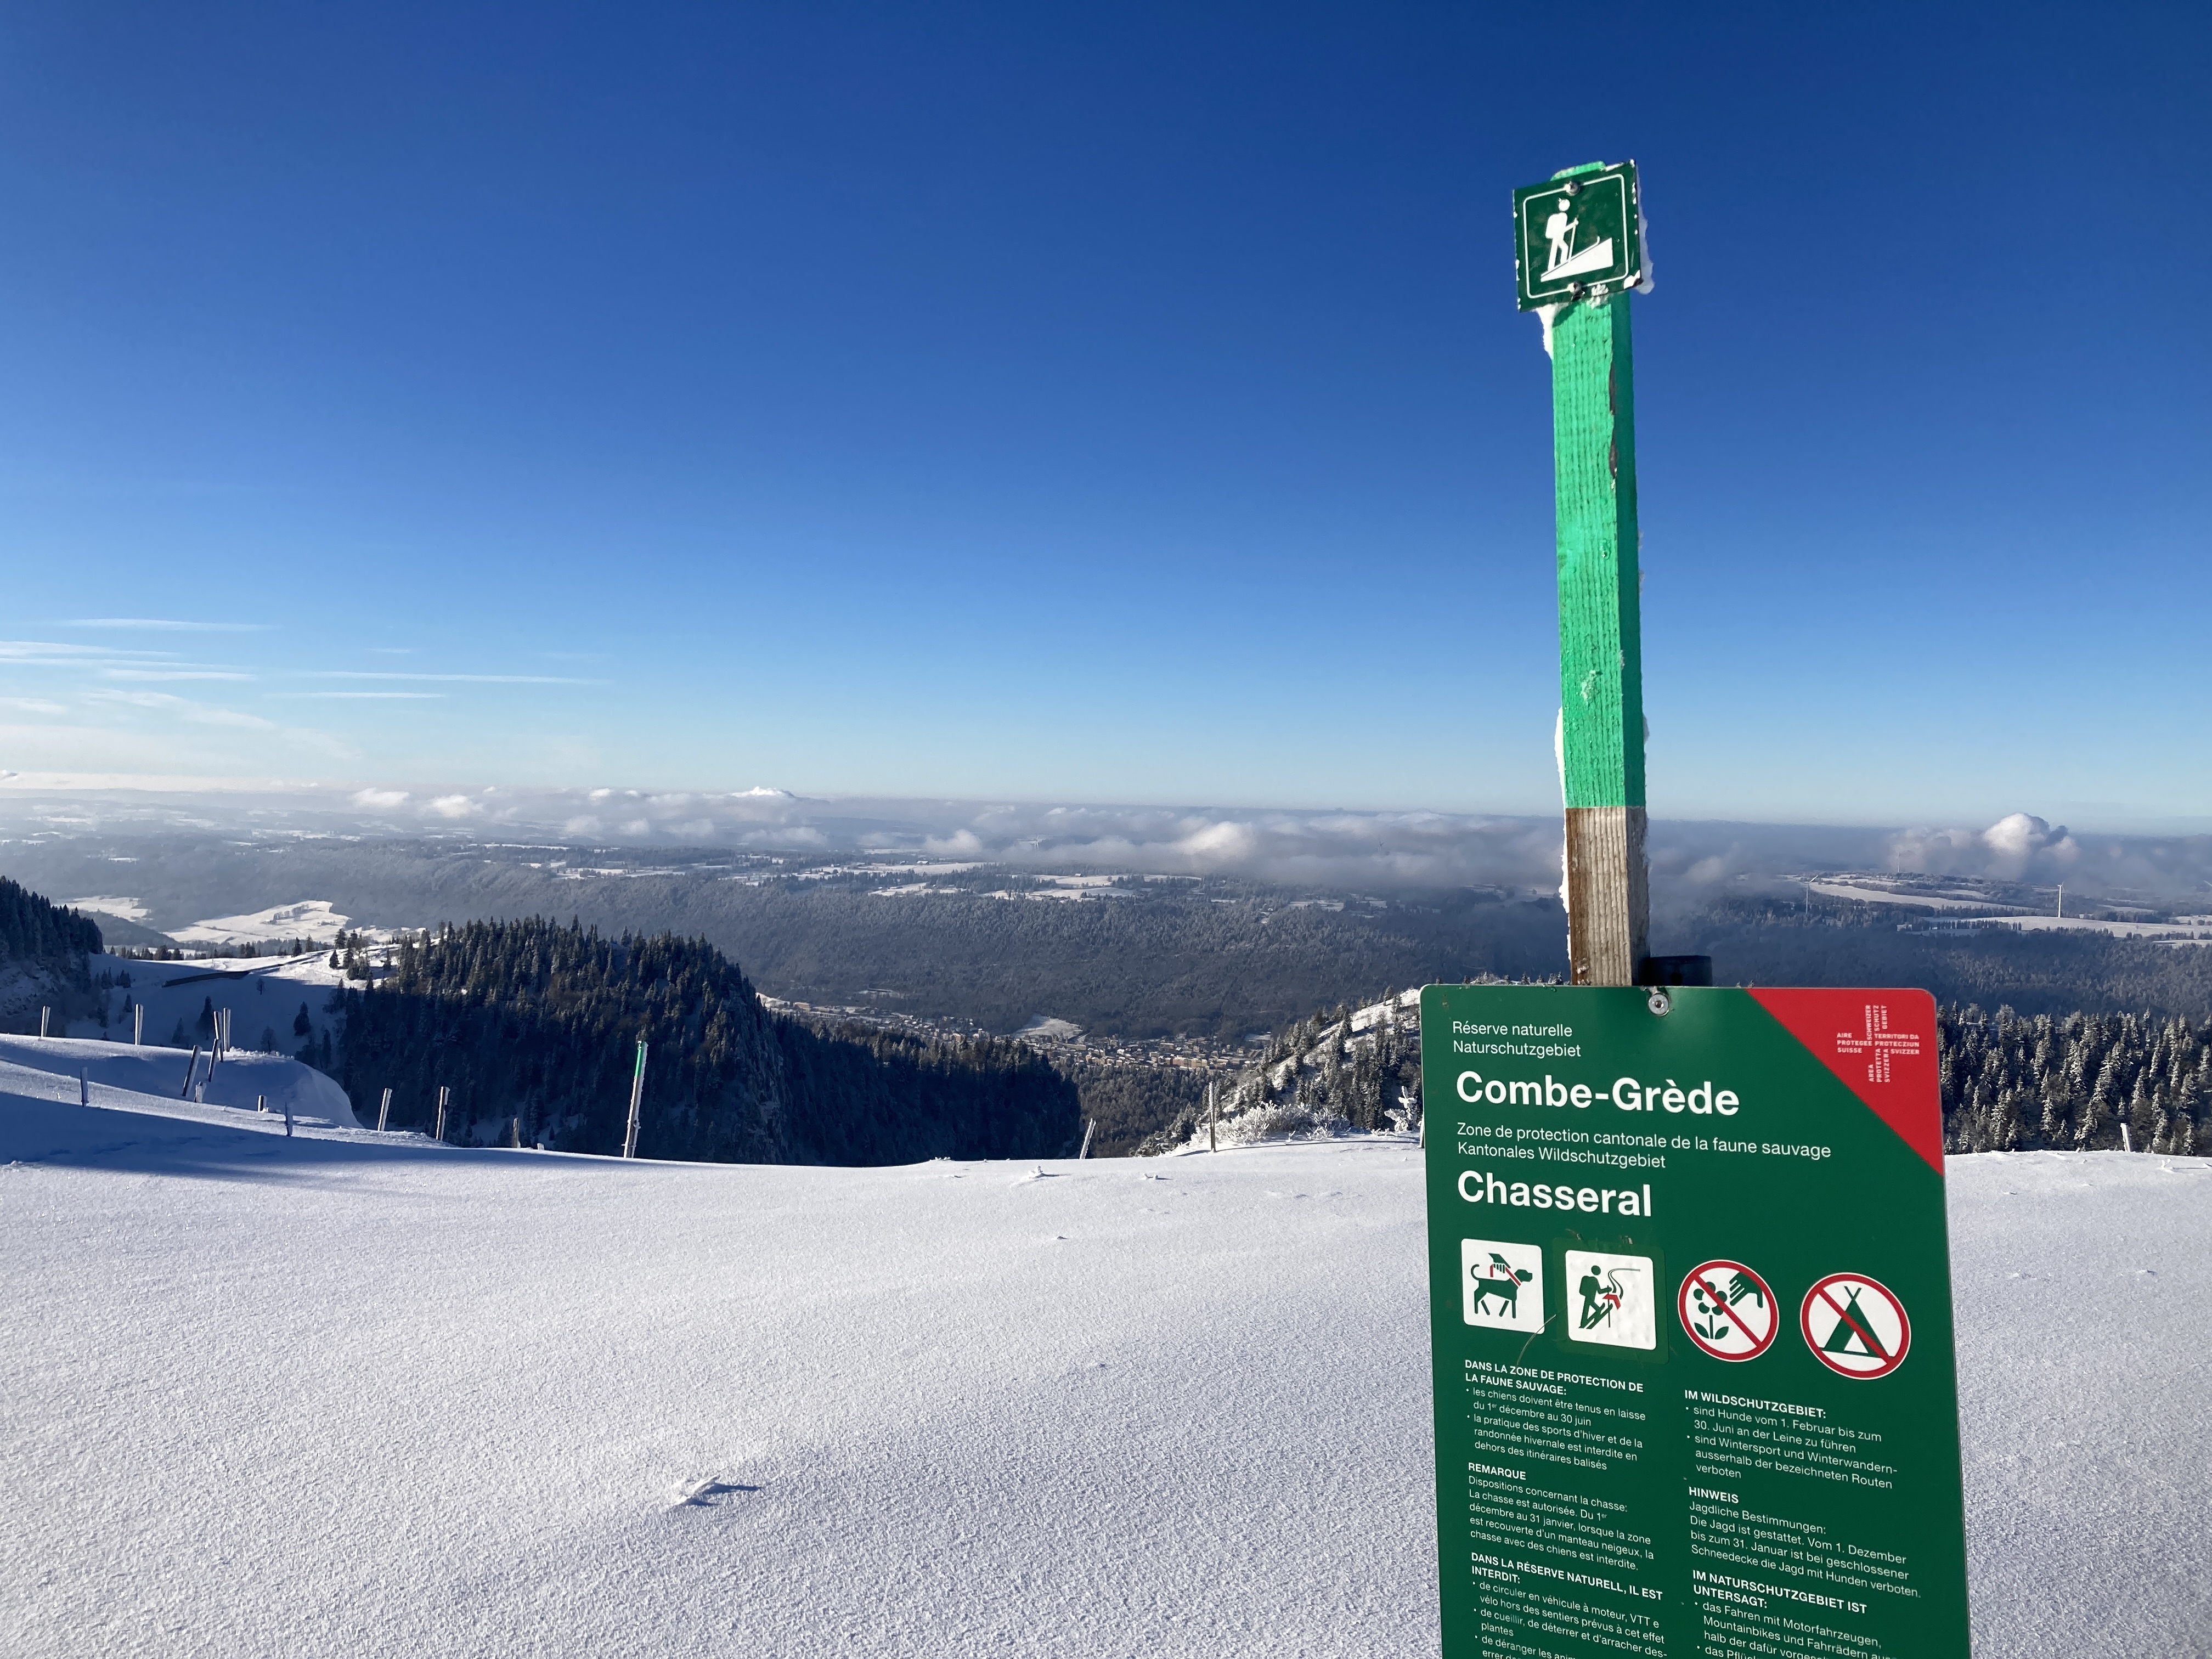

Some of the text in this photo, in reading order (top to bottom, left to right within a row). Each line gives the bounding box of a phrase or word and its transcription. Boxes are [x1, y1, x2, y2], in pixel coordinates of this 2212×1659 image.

[1453, 1020, 1572, 1037] Réserve naturelle
[1453, 1040, 1581, 1059] Naturschutzgebiet
[1456, 1070, 1740, 1116] Combe-Grède
[1457, 1122, 1831, 1161] Zone de protection cantonale de la faune sauvage
[1458, 1141, 1666, 1169] Kantonales Wildschutzgebiet
[1458, 1170, 1651, 1217] Chasseral
[1465, 1359, 1644, 1393] DANS LA ZONE DE PROTECTION DE
[1465, 1372, 1567, 1396] LA FAUNE SAUVAGE:
[1472, 1386, 1646, 1421] les chiens doivent être tenus en laisse
[1473, 1400, 1485, 1410] du
[1499, 1404, 1545, 1419] décembre
[1547, 1413, 1559, 1421] au
[1560, 1413, 1573, 1424] 30
[1575, 1415, 1592, 1426] juin
[1684, 1389, 1826, 1419] IM WILDSCHUTZGEBIET:
[1474, 1413, 1482, 1423] la
[1483, 1417, 1521, 1429] pratique
[1522, 1421, 1540, 1432] des
[1542, 1426, 1572, 1437] sports
[1607, 1435, 1617, 1444] et
[1619, 1436, 1632, 1447] de
[1634, 1438, 1643, 1448] la
[1693, 1406, 1882, 1442] sind Hunde vom 1. Februar bis zum
[1694, 1419, 1857, 1453] 30. Juni an der Leine zu führen
[1474, 1429, 1638, 1462] randonnée hivernale est interdite en
[1474, 1440, 1607, 1470] dehors des itinéraires balisés
[1694, 1434, 1898, 1474] sind Wintersport und Winterwandern-
[1468, 1462, 1526, 1481] REMARQUE
[1695, 1450, 1893, 1489] ausserhalb der bezeichneten Routen
[1695, 1464, 1741, 1479] verboten
[1469, 1475, 1628, 1513] Dispositions concernant la chasse:
[1469, 1488, 1480, 1499] La
[1482, 1492, 1514, 1505] chasse
[1516, 1499, 1530, 1508] est
[1532, 1502, 1578, 1517] autorisée.
[1580, 1508, 1594, 1520] Du
[1688, 1486, 1739, 1504] HINWEIS
[1469, 1502, 1651, 1545] décembre au 31 janvier, lorsque la zone
[1689, 1500, 1826, 1534] Jagdliche Bestimmungen:
[1470, 1517, 1483, 1526] est
[1485, 1520, 1534, 1536] recouverte
[1558, 1534, 1599, 1549] manteau
[1601, 1543, 1643, 1559] neigeux,
[1645, 1549, 1654, 1560] la
[1690, 1515, 1907, 1565] Die Jagd ist gestattet. Vom 1. Dezember
[1690, 1529, 1910, 1581] bis zum 31. Januar ist bei geschlossener
[1471, 1565, 1520, 1584] INTERDIT:
[1471, 1551, 1663, 1601] DANS LA RÉSERVE NATURELL, IL EST
[1691, 1544, 1921, 1598] Schneedecke die Jagd mit Hunden verboten.
[1692, 1569, 1867, 1614] IM NATURSCHUTZGEBIET IST
[1693, 1584, 1768, 1609] UNTERSAGT:
